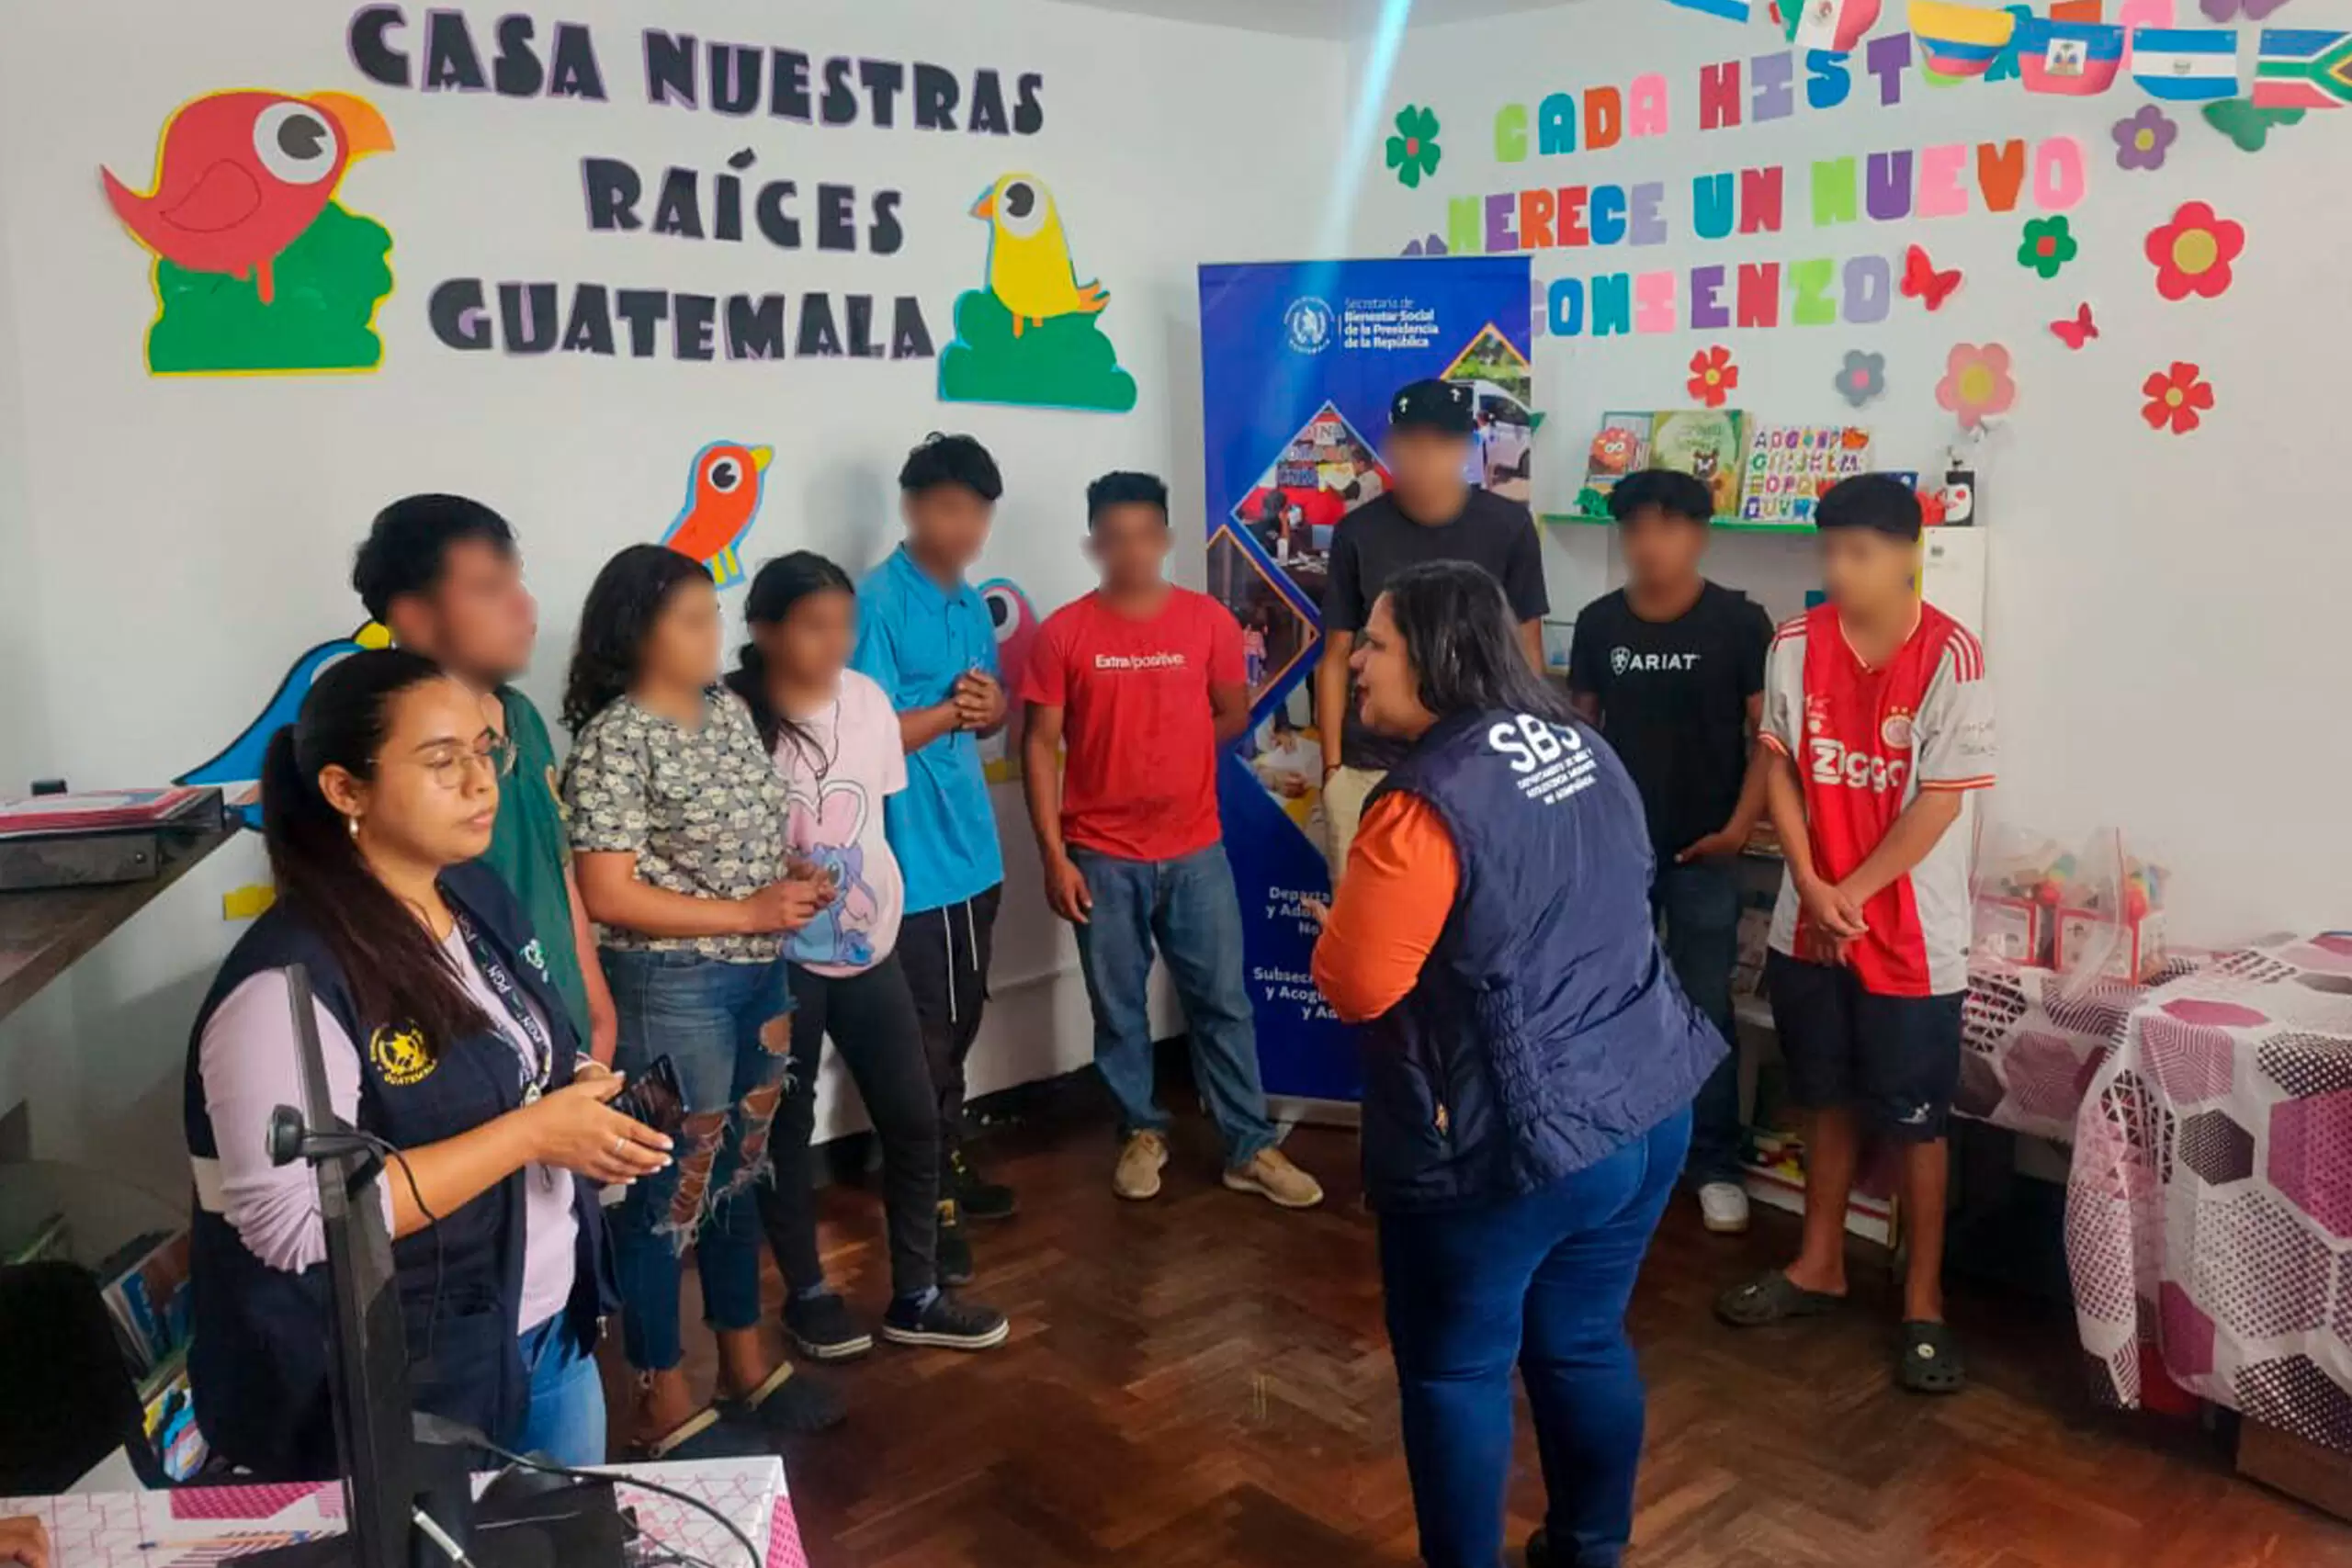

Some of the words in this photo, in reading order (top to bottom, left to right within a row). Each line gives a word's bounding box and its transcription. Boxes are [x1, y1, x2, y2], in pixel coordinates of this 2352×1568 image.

[346, 4, 608, 102] CASA
[642, 28, 1044, 136] NUESTRAS
[1494, 72, 1668, 164] CADA
[581, 147, 904, 254] RAÍCES
[1448, 182, 1667, 255] MERECE
[1692, 165, 1783, 239] UN
[1810, 136, 2086, 228] NUEVO
[1400, 296, 1414, 309] de
[428, 278, 936, 362] GUATEMALA
[1344, 310, 1397, 321] Bienestar
[1400, 309, 1435, 321] Social
[1344, 323, 1358, 335] de
[1361, 323, 1371, 335] la
[1374, 322, 1440, 335] Presidencia
[1344, 336, 1358, 348] de
[1361, 336, 1372, 348] la
[1374, 335, 1430, 351] República
[1629, 653, 1699, 671] ARIAT
[1266, 905, 1276, 919] y
[1265, 986, 1275, 1002] y
[1301, 1006, 1312, 1021] y
